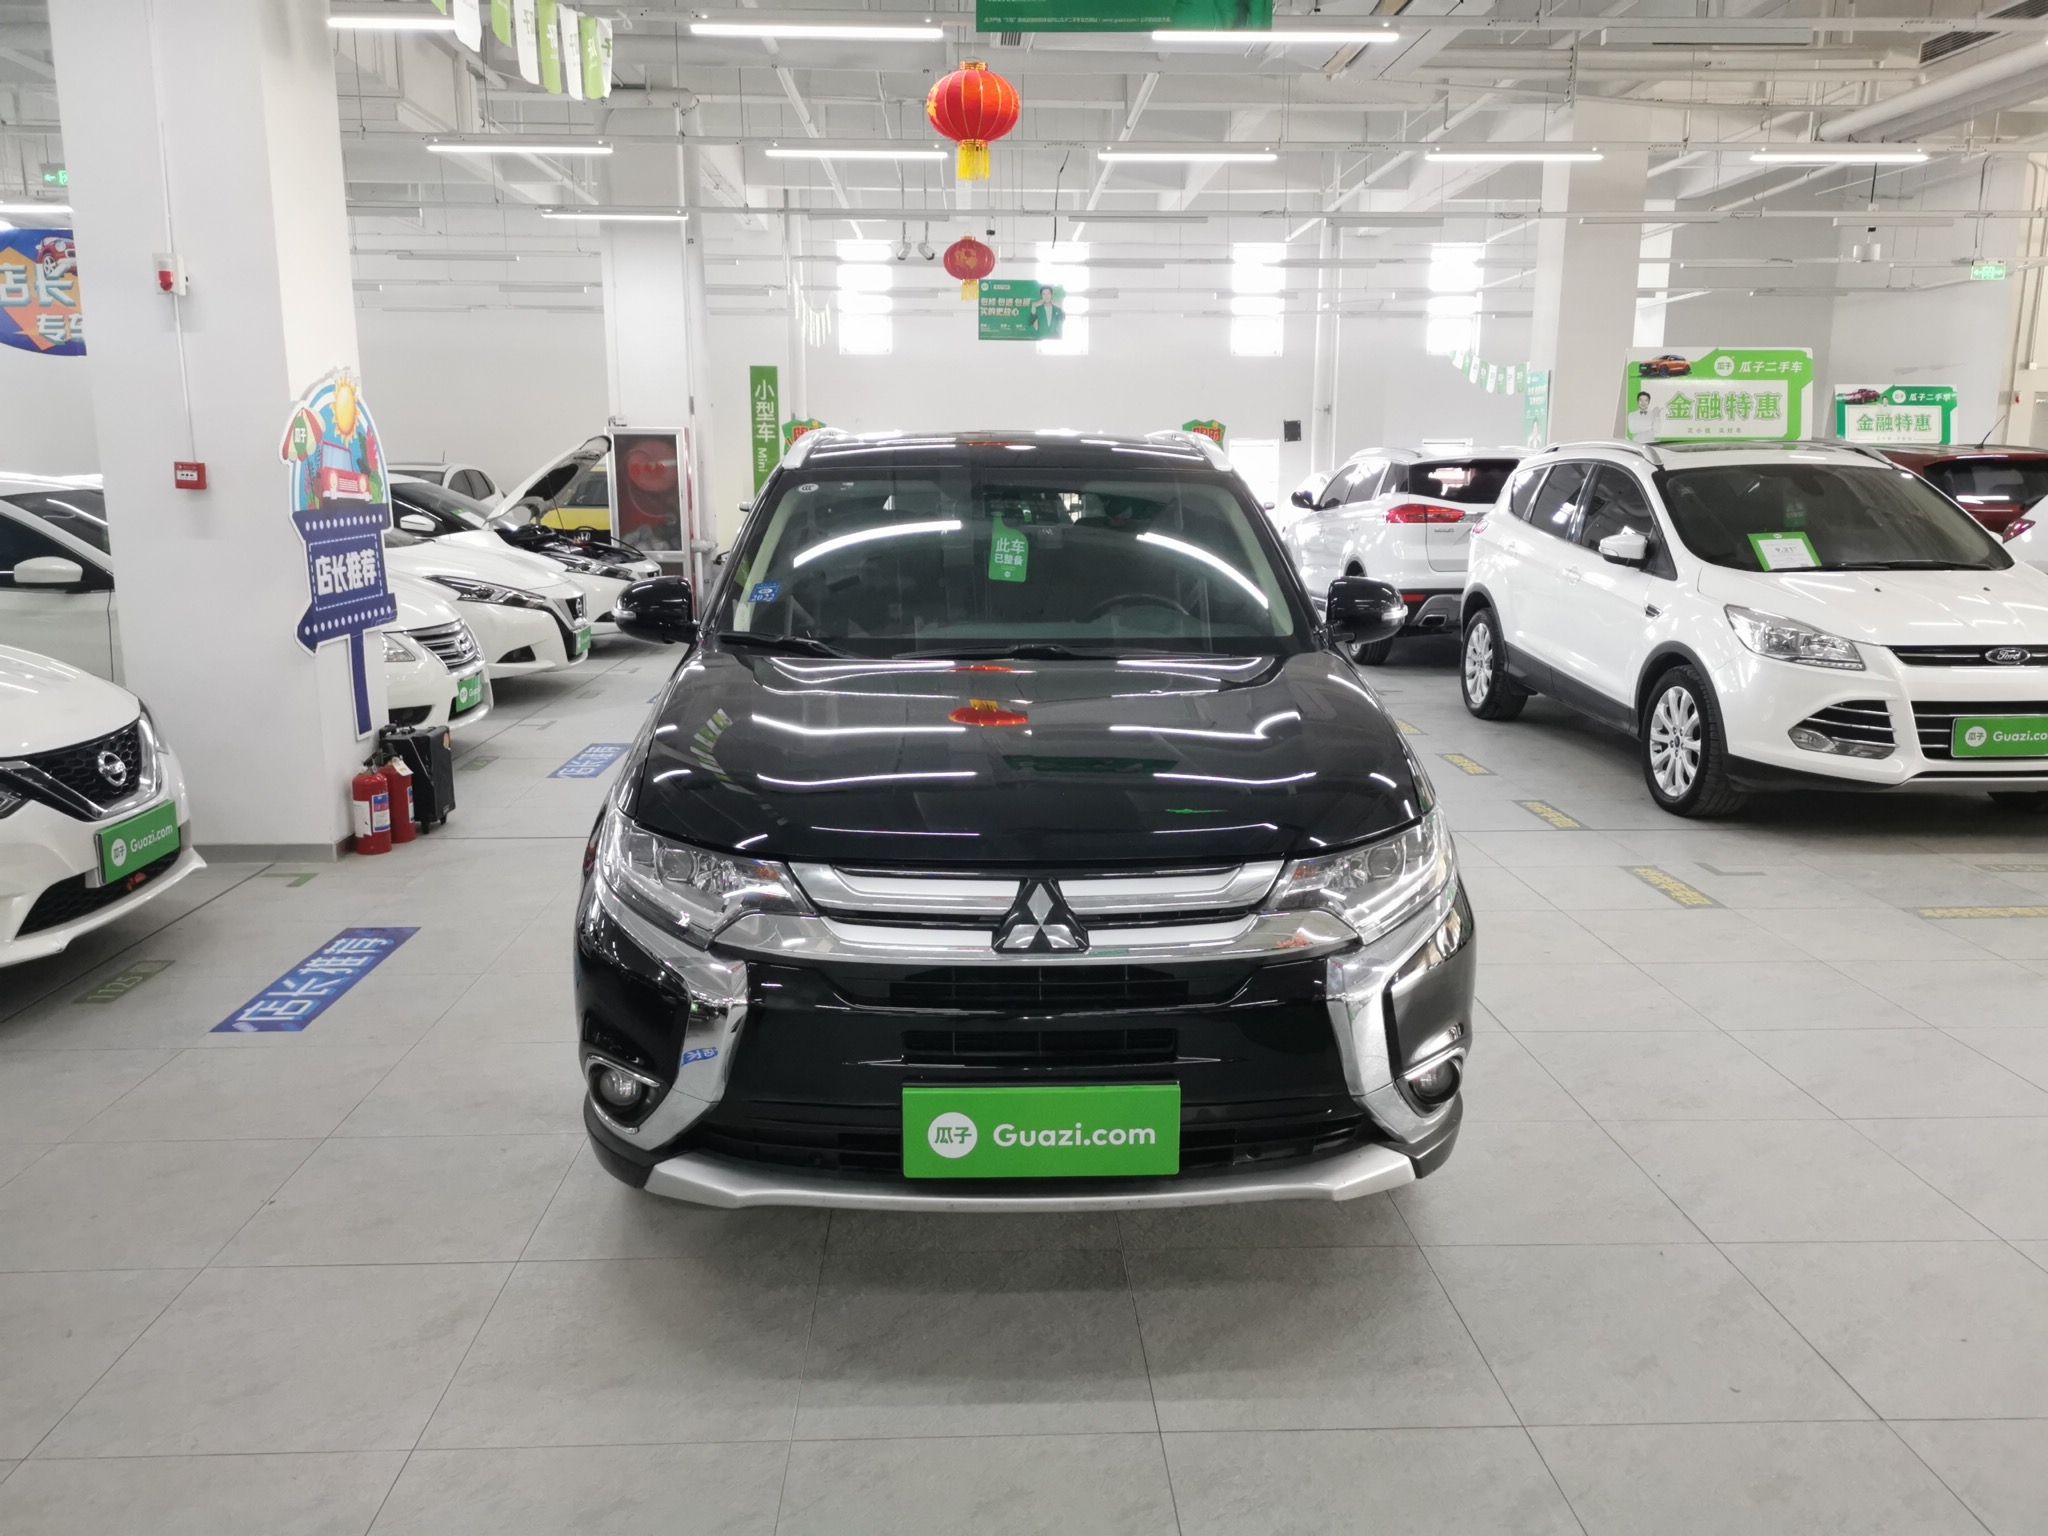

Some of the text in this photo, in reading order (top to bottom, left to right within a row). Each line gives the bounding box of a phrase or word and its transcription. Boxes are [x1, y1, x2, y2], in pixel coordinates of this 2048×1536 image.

[1739, 361, 1802, 373] 瓜子二手车
[755, 380, 776, 443] 小型车
[1666, 391, 1782, 421] 金融特惠
[1856, 413, 1932, 432] 金融特惠
[758, 447, 768, 472] Mini
[995, 538, 1025, 554] 此车
[315, 549, 377, 596] 店长推荐
[1997, 649, 2021, 661] Ford
[1967, 732, 1985, 741] 瓜子
[130, 824, 173, 853] Guazi.com
[235, 937, 389, 1021] 店长推荐
[934, 1122, 1156, 1148] 瓜子 Guazi.com
